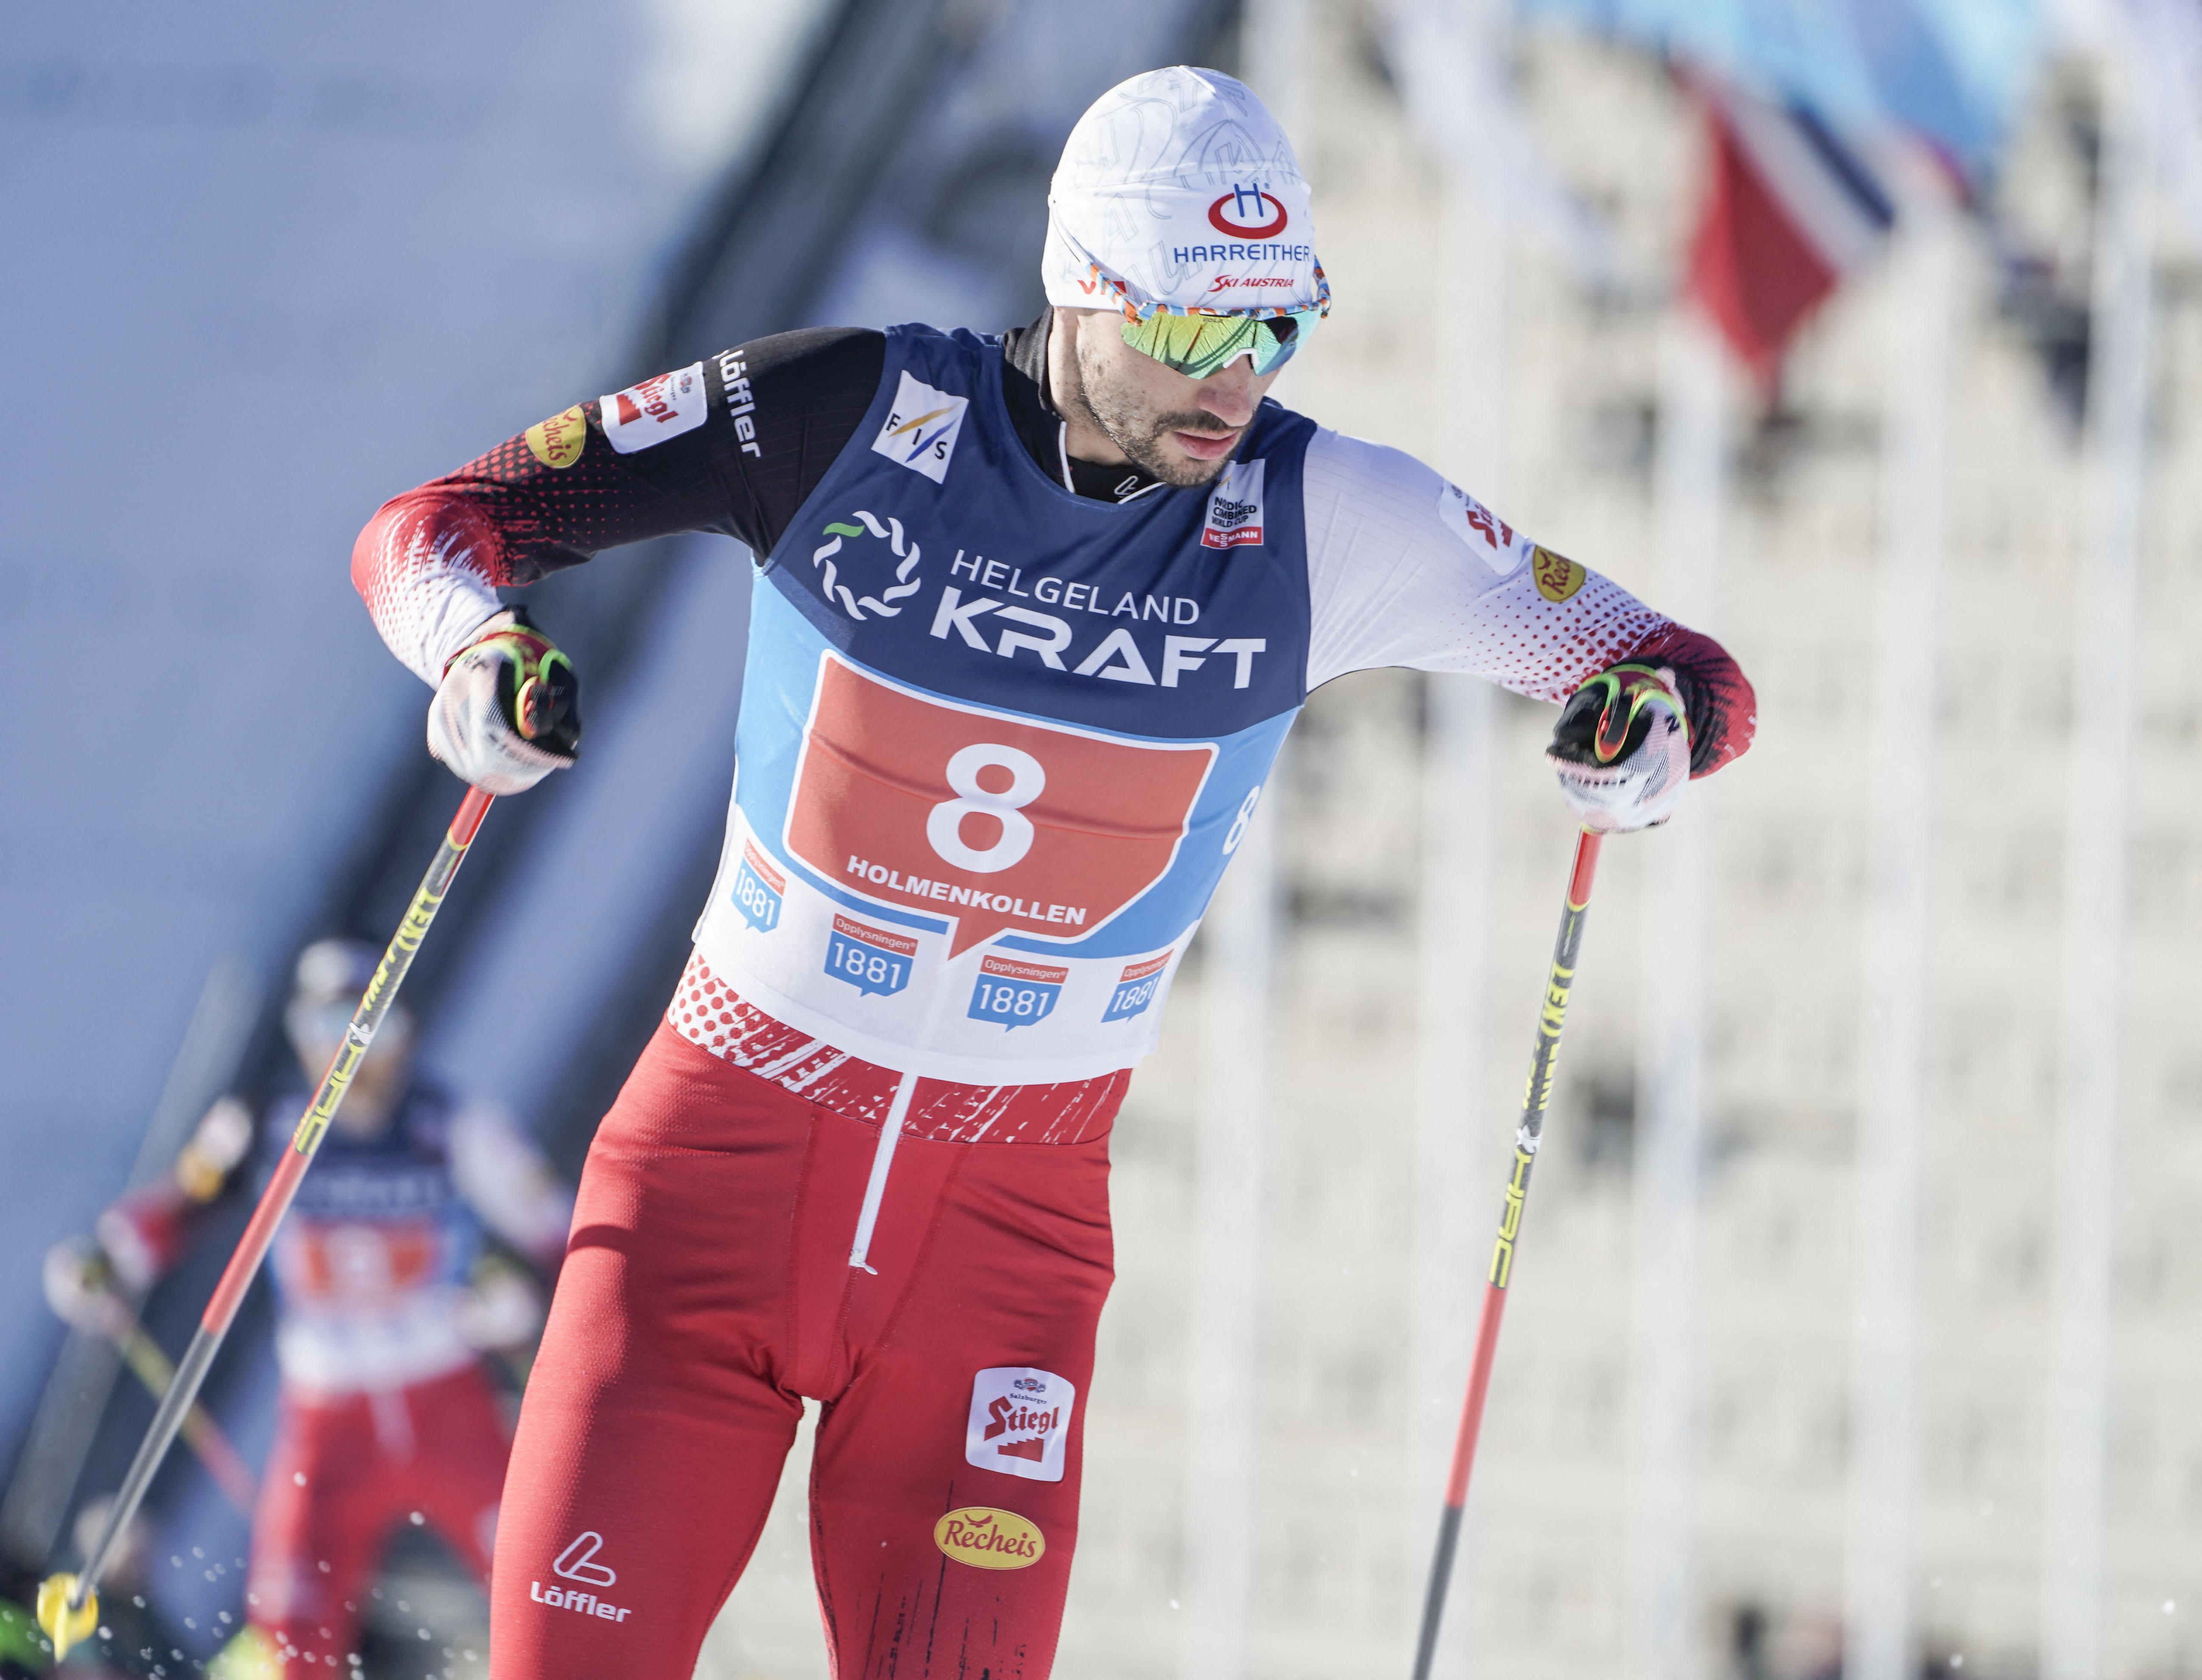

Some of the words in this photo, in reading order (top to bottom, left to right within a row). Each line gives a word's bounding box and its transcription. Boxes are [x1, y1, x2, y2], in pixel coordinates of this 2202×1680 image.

[1174, 244, 1310, 263] HARREITHER
[1239, 278, 1295, 288] AUSTRIA
[543, 417, 571, 461] cheis
[950, 550, 1199, 625] HELGELAND
[929, 586, 1266, 689] KRAFT
[926, 743, 1046, 873] 8
[1222, 785, 1260, 855] 8
[736, 869, 774, 926] 1881
[847, 855, 1086, 925] HOLMENKOLLEN
[835, 942, 901, 989] 1881
[980, 984, 1050, 1017] 1881
[1112, 976, 1159, 1012] 1881
[984, 1395, 1060, 1441] Stiegl
[943, 1520, 1037, 1558] Recheis
[530, 1581, 632, 1622] Löffler
